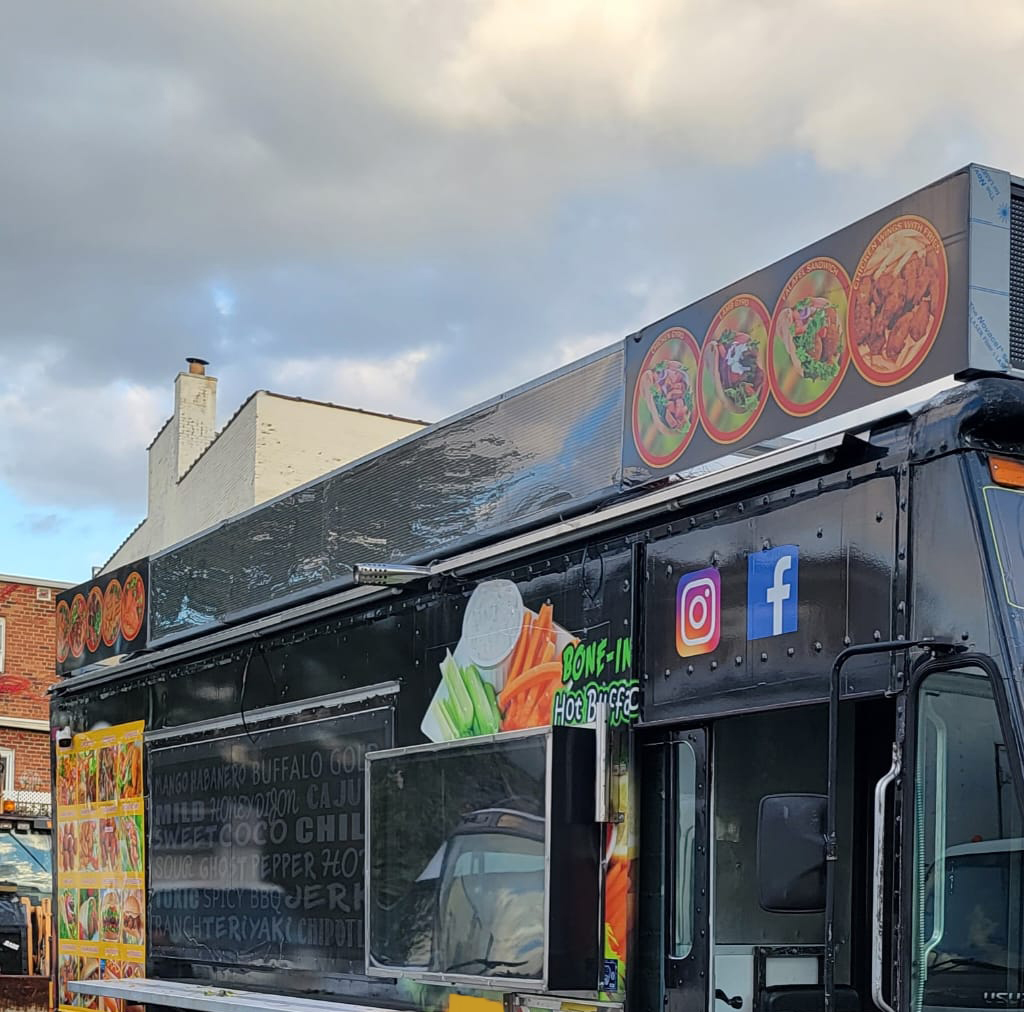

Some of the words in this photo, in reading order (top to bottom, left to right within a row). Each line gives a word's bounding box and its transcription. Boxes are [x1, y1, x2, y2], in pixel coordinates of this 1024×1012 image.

[877, 222, 904, 242] WINGS
[904, 220, 923, 232] WITH
[922, 226, 940, 254] FRIES
[806, 261, 838, 276] SANDWICH
[766, 555, 791, 635] f
[554, 693, 582, 725] Hot
[154, 773, 189, 796] MANGO
[190, 764, 247, 794] HABANERO
[252, 751, 323, 785] BUFFALO
[330, 743, 377, 776] GOL
[155, 799, 205, 826] MILD
[210, 794, 256, 823] HONEY
[153, 825, 219, 850] SWEET
[219, 818, 288, 847] COCO
[200, 855, 248, 881] GHOST
[253, 852, 316, 881] PEPPER
[203, 887, 244, 909] SPICY
[251, 888, 281, 914] BBQ
